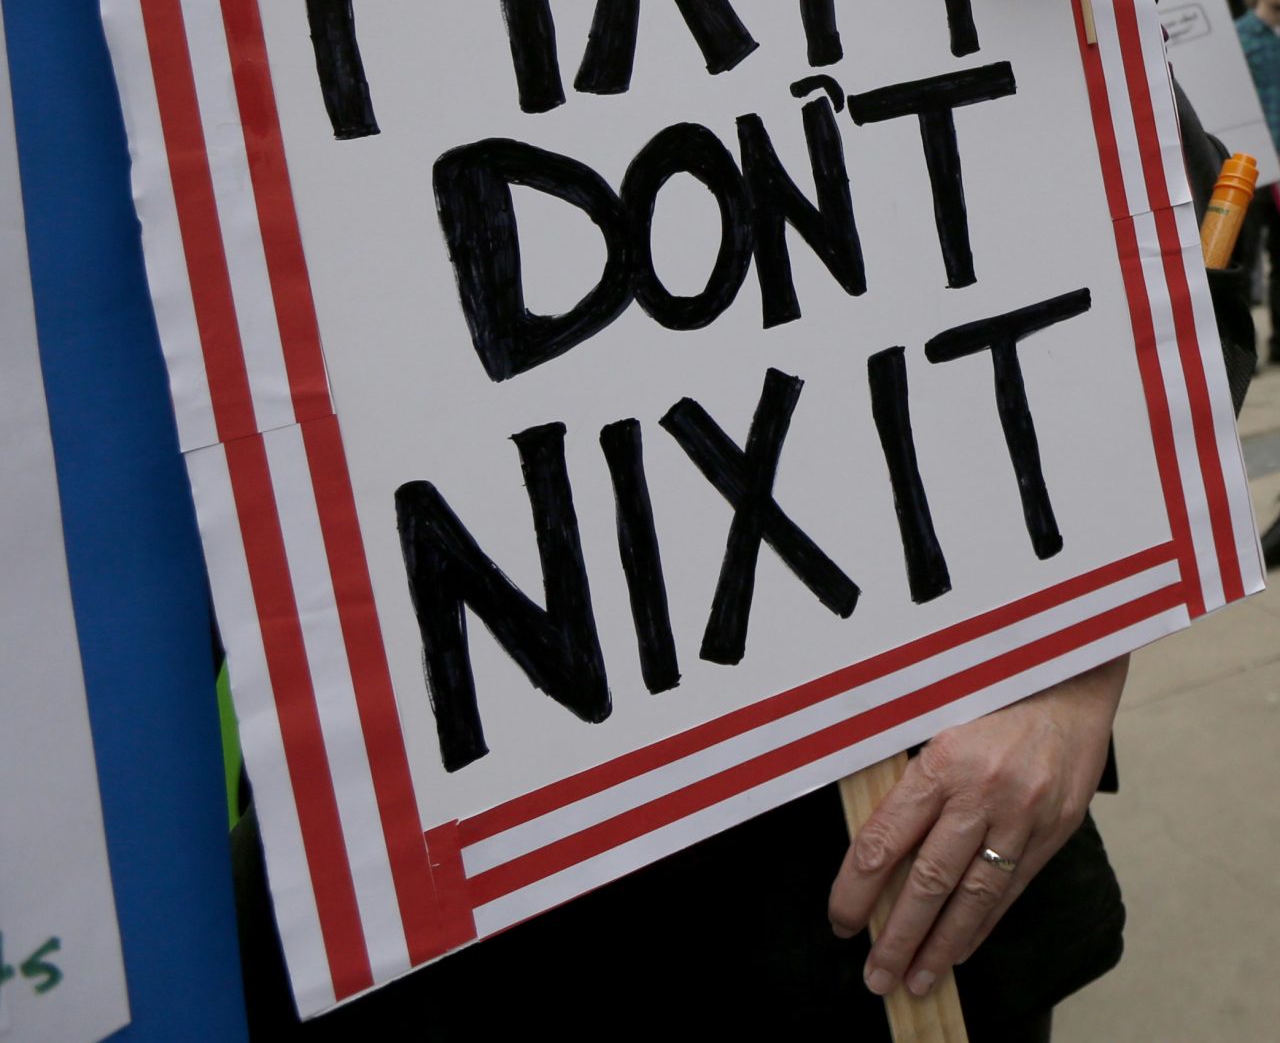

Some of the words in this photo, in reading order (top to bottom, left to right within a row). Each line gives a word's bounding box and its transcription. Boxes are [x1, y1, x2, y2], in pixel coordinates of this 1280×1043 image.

[432, 60, 1017, 384] DON'T
[394, 367, 861, 774] NIX
[866, 287, 1093, 604] IT
